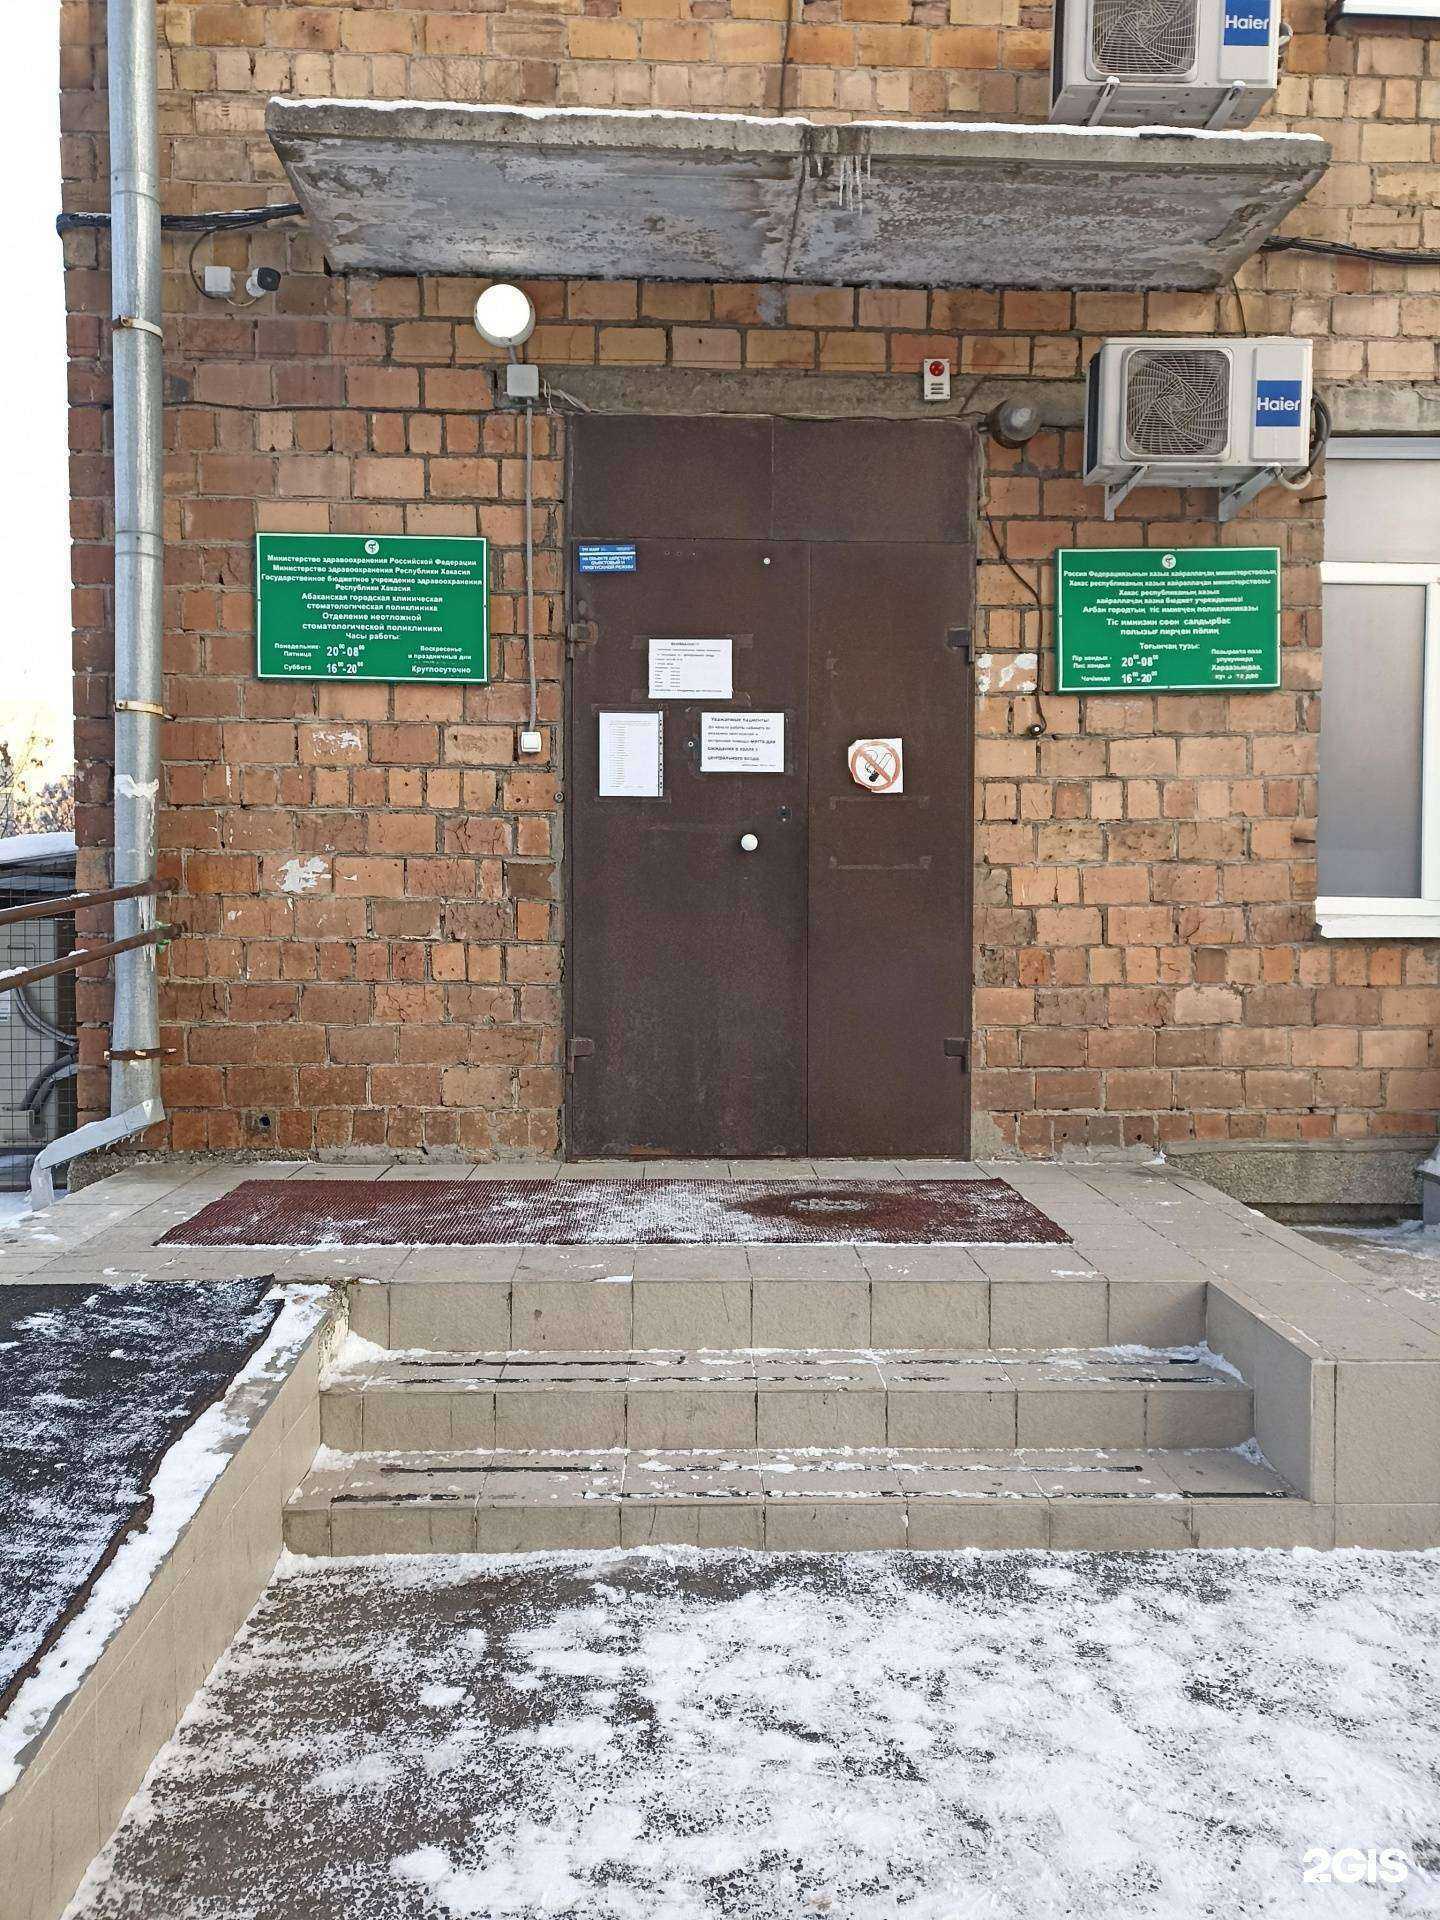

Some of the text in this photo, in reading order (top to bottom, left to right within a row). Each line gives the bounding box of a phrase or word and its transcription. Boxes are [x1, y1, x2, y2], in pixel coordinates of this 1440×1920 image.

[1225, 14, 1270, 30] Haier
[1257, 396, 1301, 411] Haier
[267, 554, 477, 566] Министерство здравоохранения Российской Федерации
[272, 564, 327, 573] Министерство
[395, 566, 439, 575] Республики
[261, 573, 326, 582] Государственное
[327, 575, 369, 583] бюджетное
[416, 578, 483, 586] здравоохранения
[335, 583, 411, 592] Республики Хакасия
[301, 592, 443, 603] Абаканская городская клиническая
[322, 612, 422, 621] Отделение неотложной
[302, 623, 384, 631] стоматологической
[345, 632, 367, 640] Часы
[420, 645, 463, 653] Воскресенье
[283, 650, 312, 658] Пятница
[283, 663, 312, 672] Суббота
[411, 665, 471, 674] Круглосуточно
